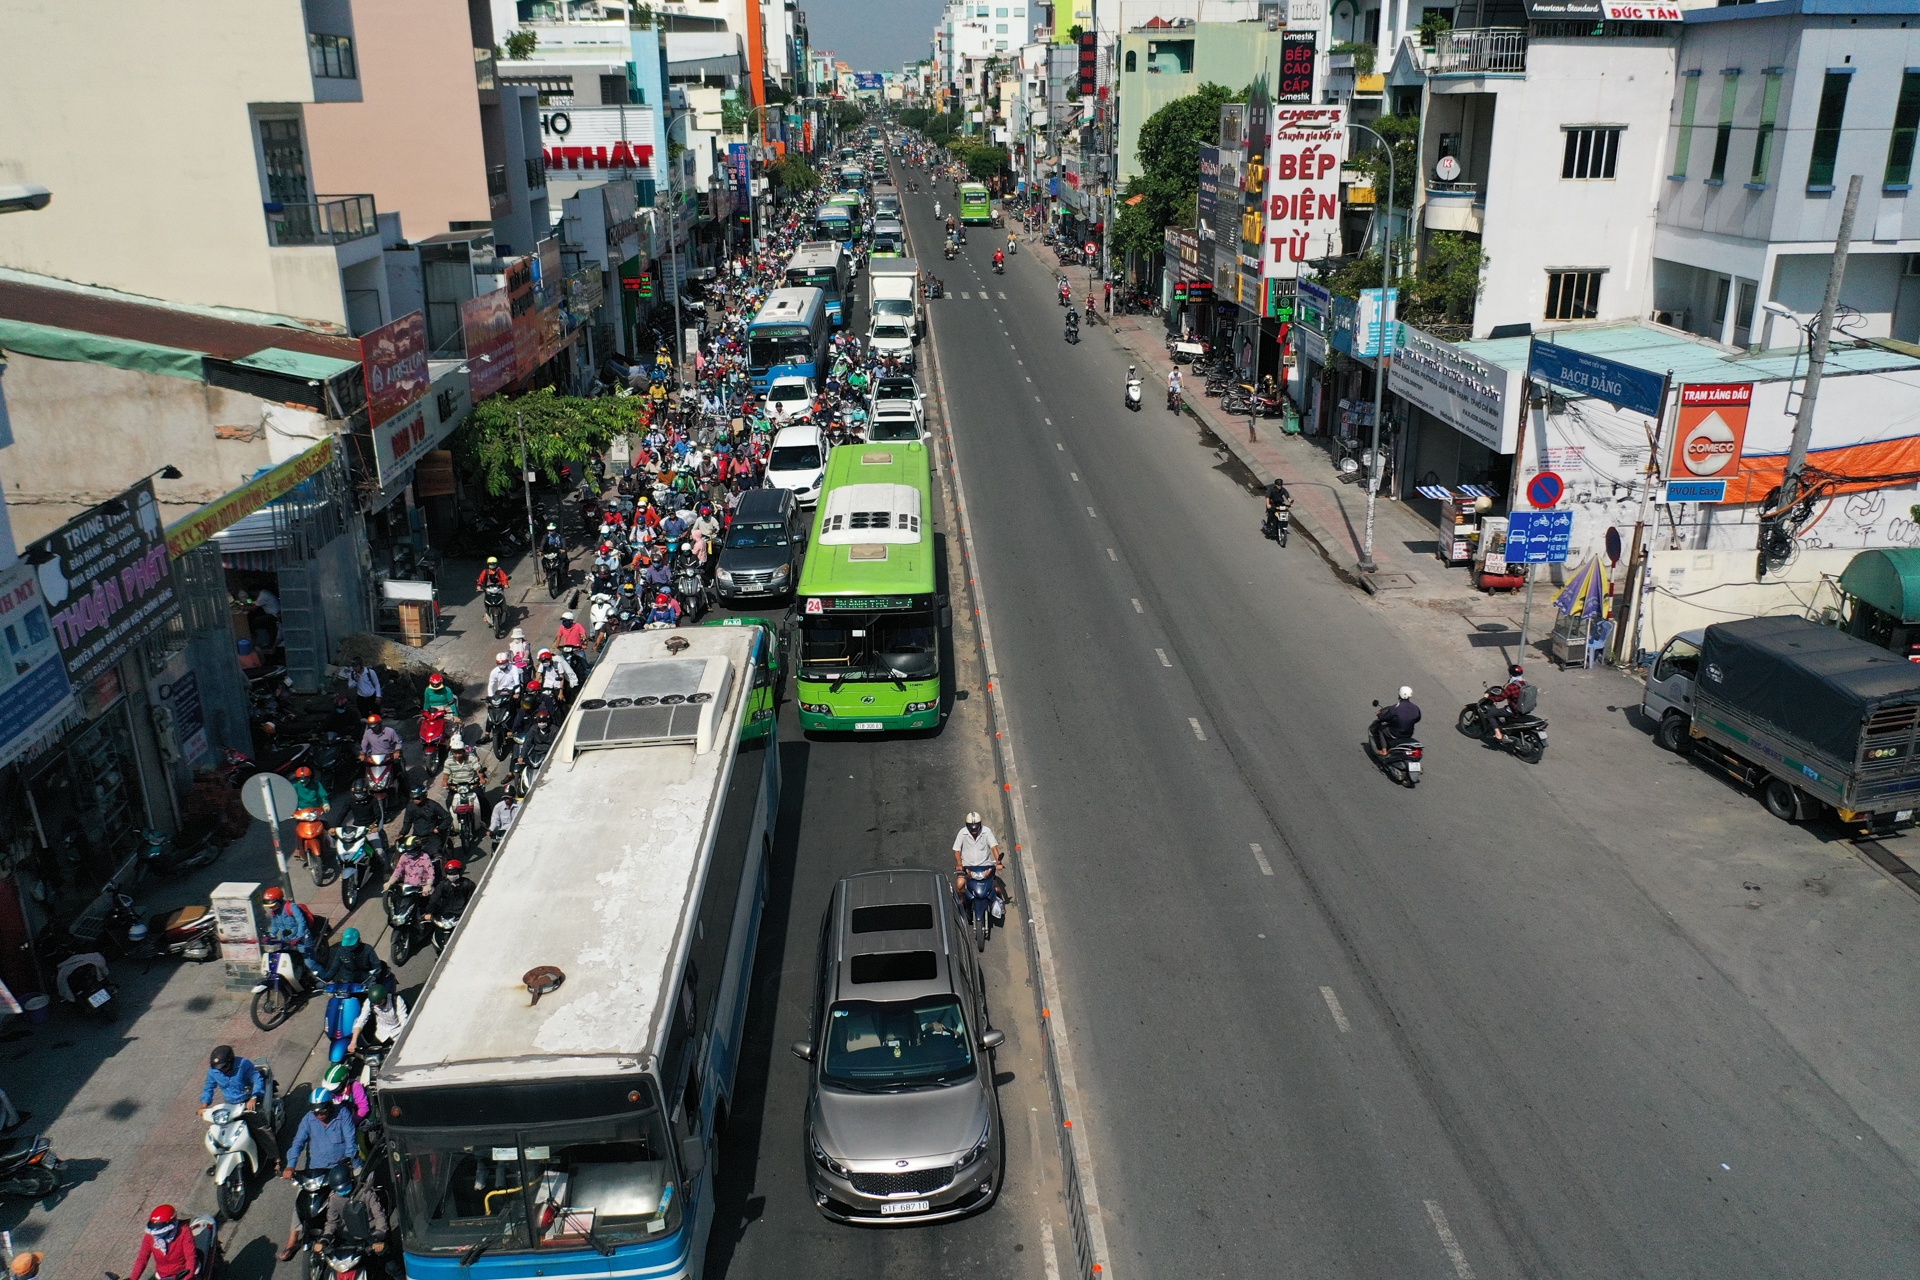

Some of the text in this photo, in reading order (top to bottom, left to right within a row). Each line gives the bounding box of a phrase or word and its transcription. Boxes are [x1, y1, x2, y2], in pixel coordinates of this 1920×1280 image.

[1532, 3, 1565, 12] American
[1566, 3, 1599, 12] Standard
[1611, 4, 1643, 19] ĐỨC
[1646, 6, 1679, 20] TÂN
[1285, 45, 1312, 60] BẾP
[1284, 62, 1311, 74] CAO
[1283, 76, 1310, 92] CẤP
[1278, 110, 1342, 122] CHEF'S
[1278, 144, 1336, 180] BẾP
[1270, 187, 1336, 226] ĐIỆN
[1270, 229, 1310, 262] TỪ
[1435, 346, 1446, 358] TY
[1591, 372, 1622, 396] ĐẰNG
[1684, 387, 1750, 402] TRẠM XĂNG DẦU
[1688, 442, 1735, 454] COMECO
[1669, 486, 1720, 496] PVOIL Easy
[63, 515, 105, 551] TRUNG
[119, 537, 142, 562] LAPTOP
[52, 576, 123, 649] THUẬN
[808, 600, 820, 612] 24
